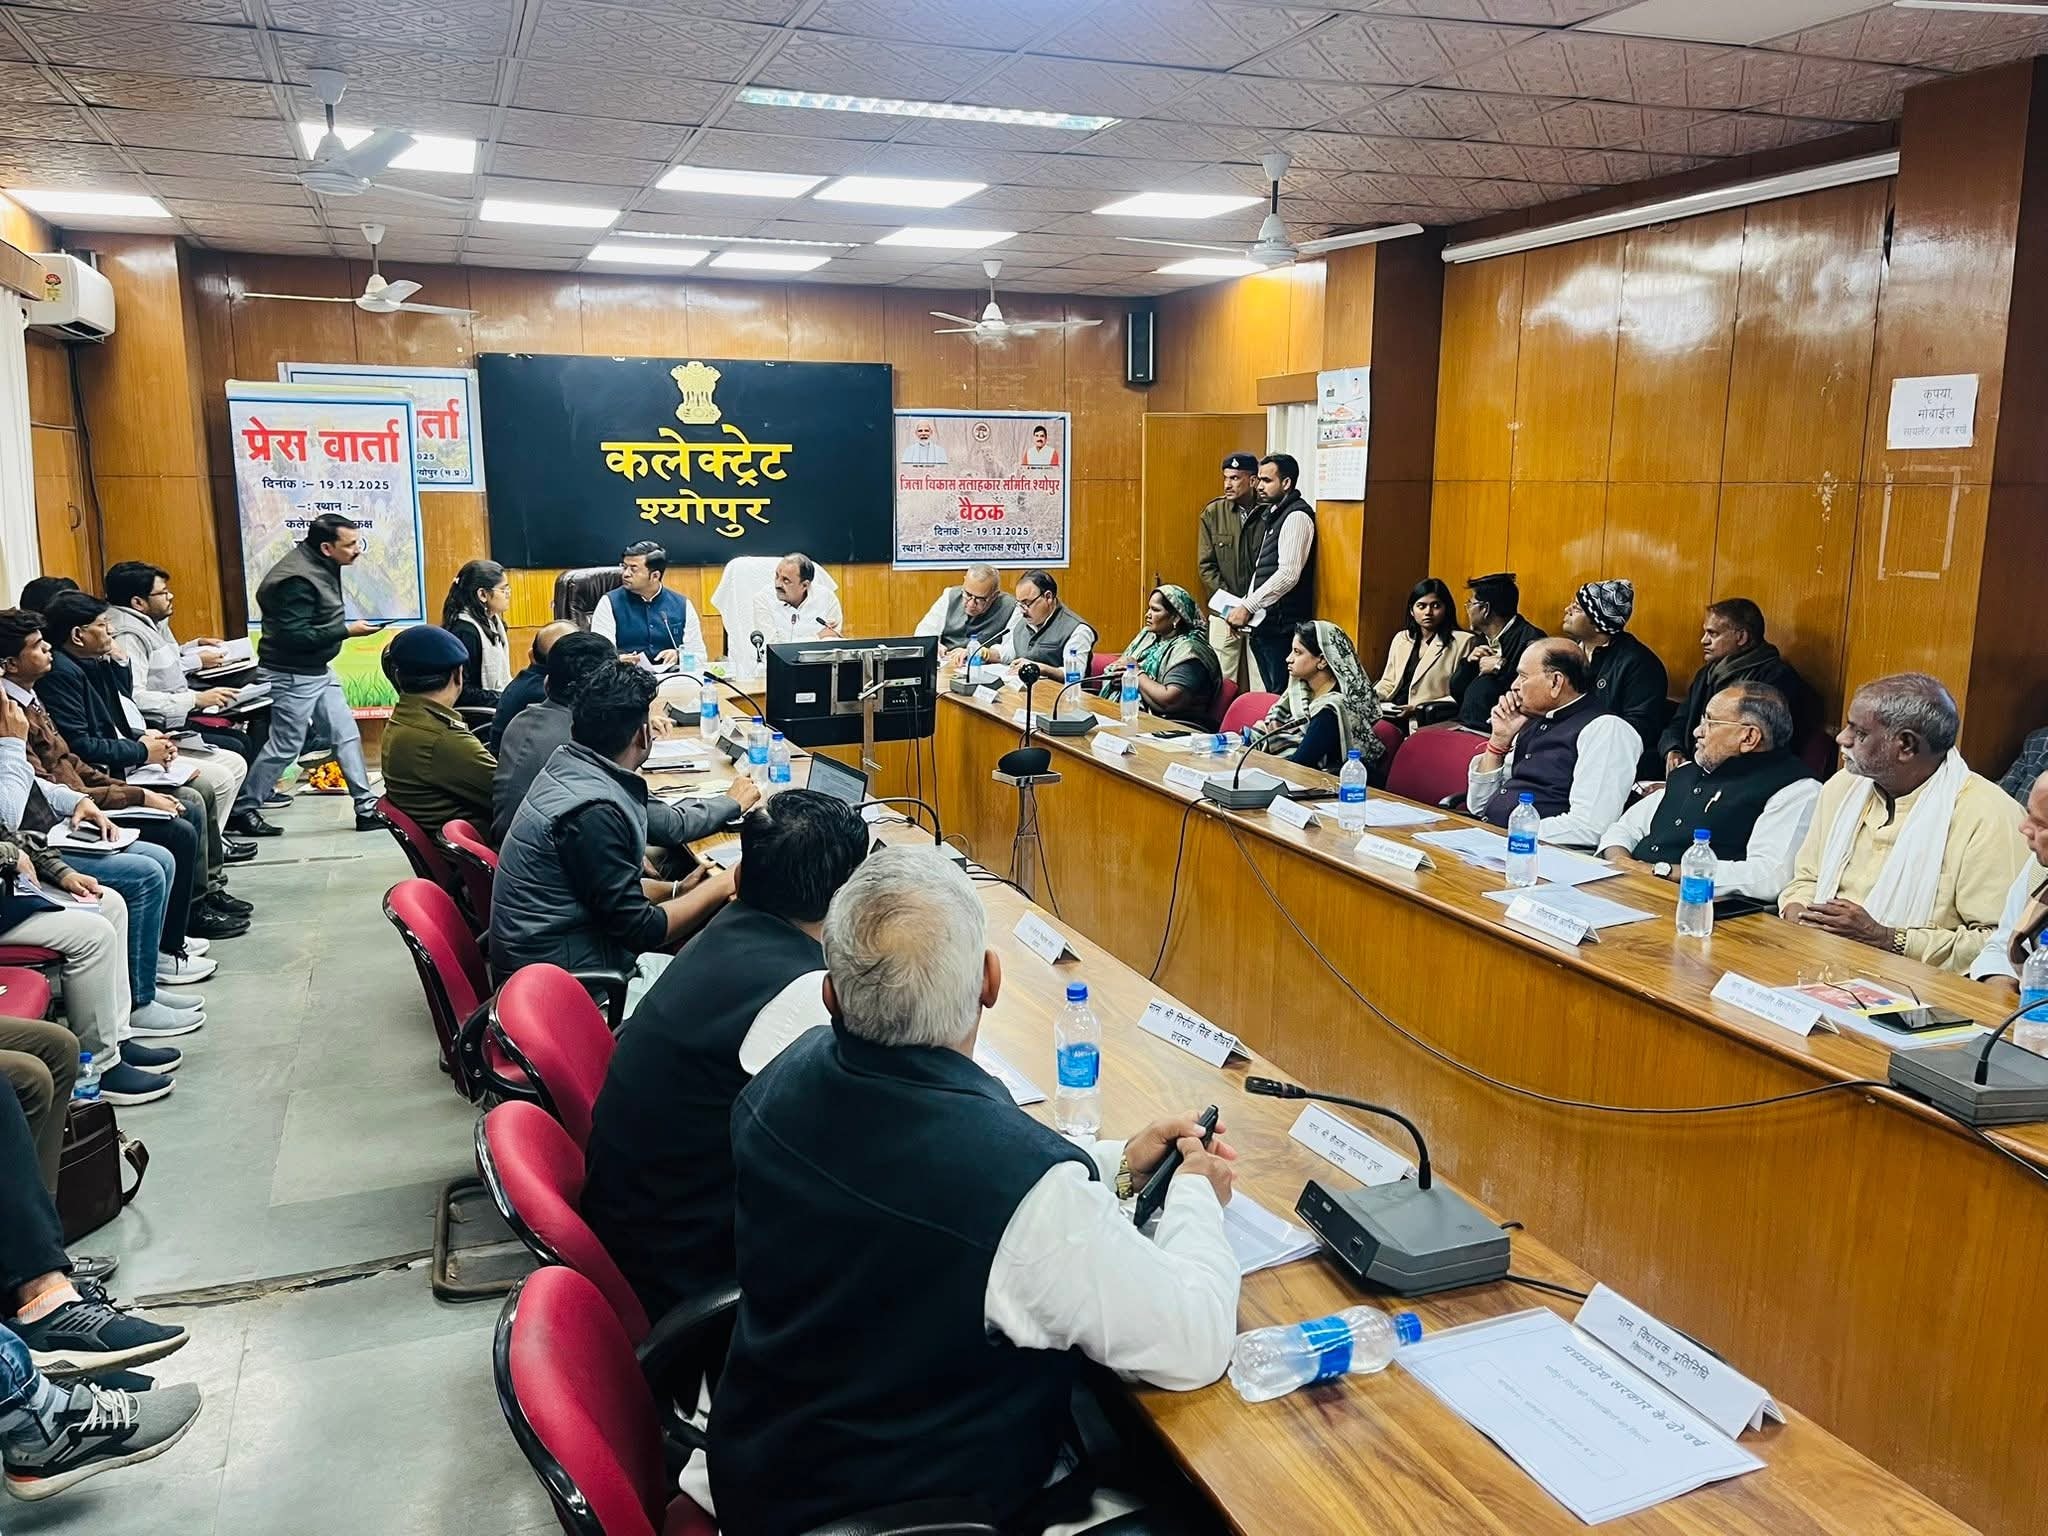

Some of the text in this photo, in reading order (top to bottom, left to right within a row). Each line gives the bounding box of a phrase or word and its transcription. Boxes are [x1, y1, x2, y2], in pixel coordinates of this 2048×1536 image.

[241, 415, 400, 463] प्रेस वार्ता
[600, 423, 793, 487] कलेक्ट्रेट
[262, 476, 297, 490] दिनांक
[319, 479, 390, 491] 19.12.2025
[899, 474, 923, 491] जिला
[925, 474, 957, 491] विकास
[1002, 474, 1031, 491] समिति
[1032, 475, 1061, 496] श्योपुर
[635, 488, 771, 538] श्योपुर
[958, 496, 1005, 521] बैठक
[976, 527, 1029, 537] 19.12.2025
[1637, 1326, 1673, 1355] विधायक
[1610, 1379, 1654, 1410] सरकार
